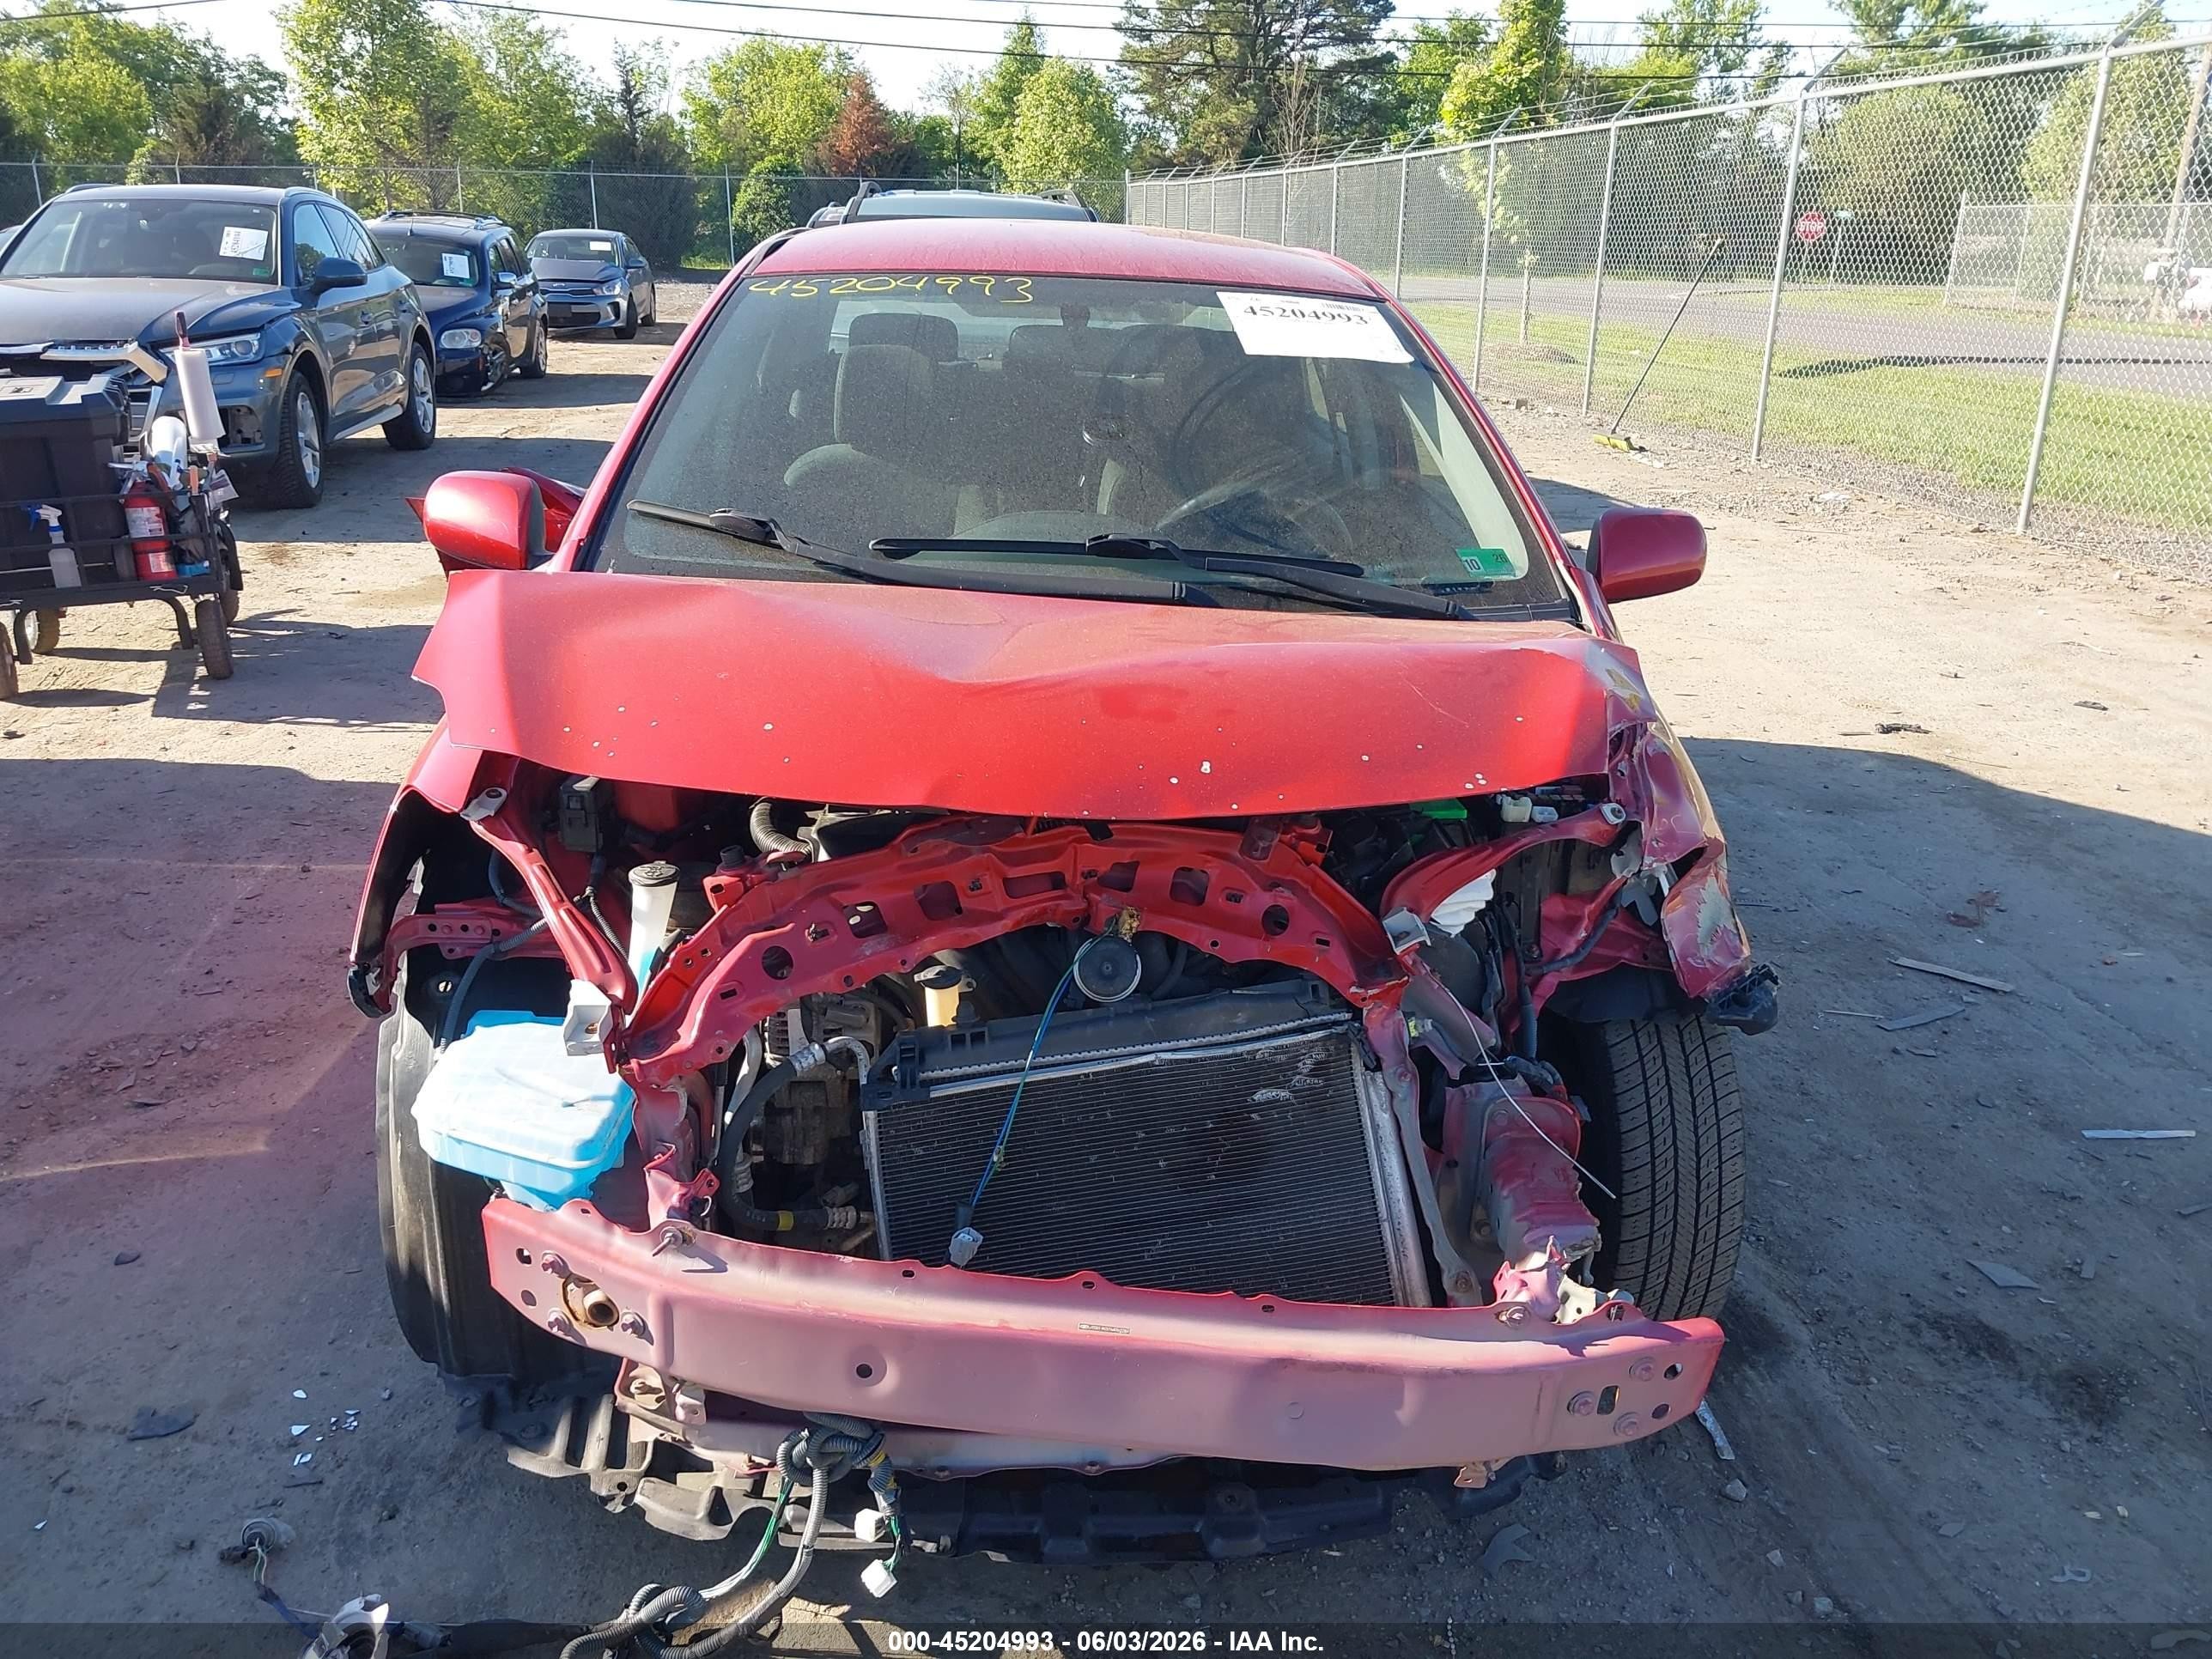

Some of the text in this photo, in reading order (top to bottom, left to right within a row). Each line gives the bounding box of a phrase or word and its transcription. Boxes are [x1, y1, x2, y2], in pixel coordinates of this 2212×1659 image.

[1799, 221, 1824, 232] STOP
[749, 276, 1033, 303] 45204993
[1243, 305, 1370, 325] 45204993
[1462, 558, 1481, 571] 10
